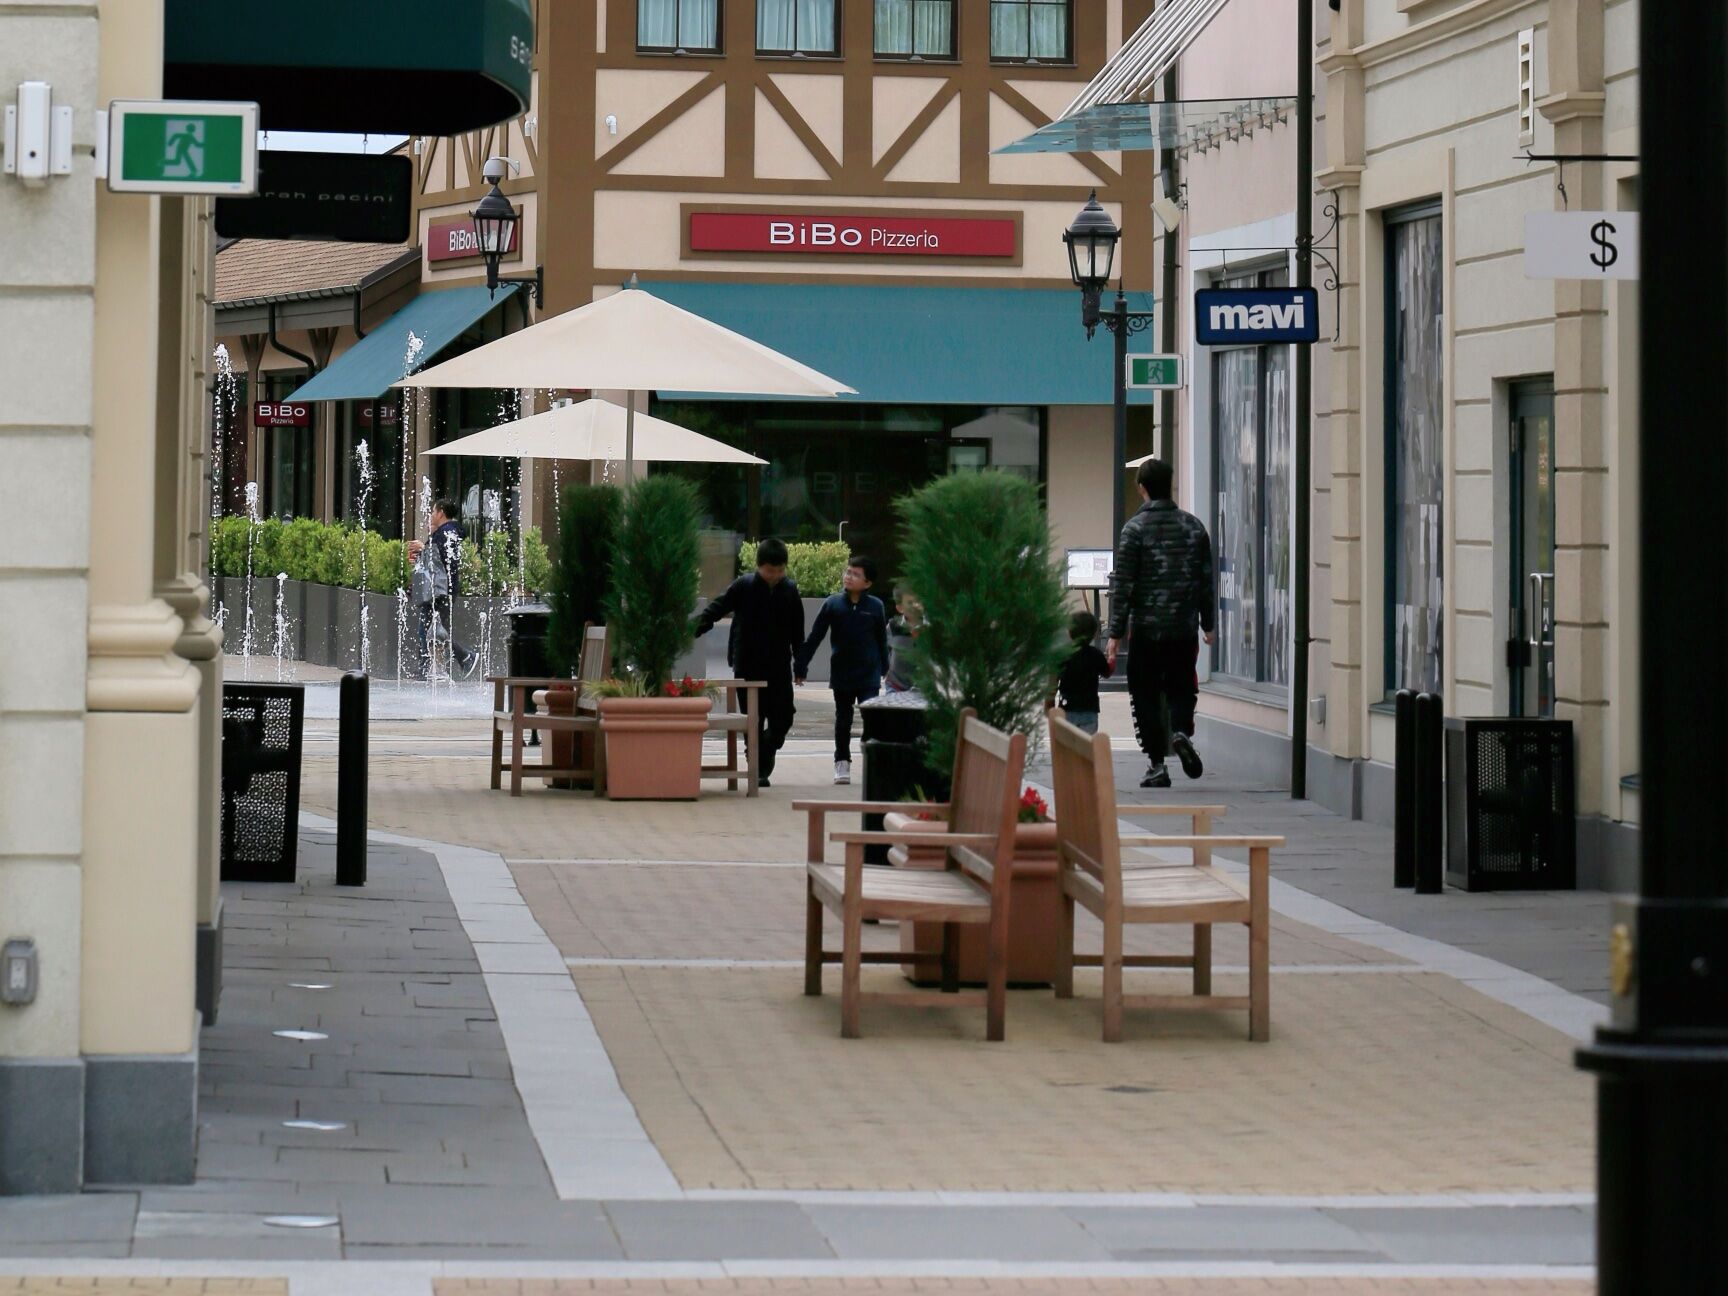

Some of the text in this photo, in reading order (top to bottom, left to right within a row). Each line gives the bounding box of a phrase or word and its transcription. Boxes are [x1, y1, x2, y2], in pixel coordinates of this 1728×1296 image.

[318, 192, 393, 203] pacini
[449, 229, 472, 252] BiBo
[769, 222, 939, 248] BiBo Pizzeria
[1589, 219, 1618, 272] $
[1210, 296, 1305, 330] mavi
[259, 405, 306, 417] BiBo
[270, 417, 294, 425] Pizzeria
[1220, 563, 1235, 600] mavi
